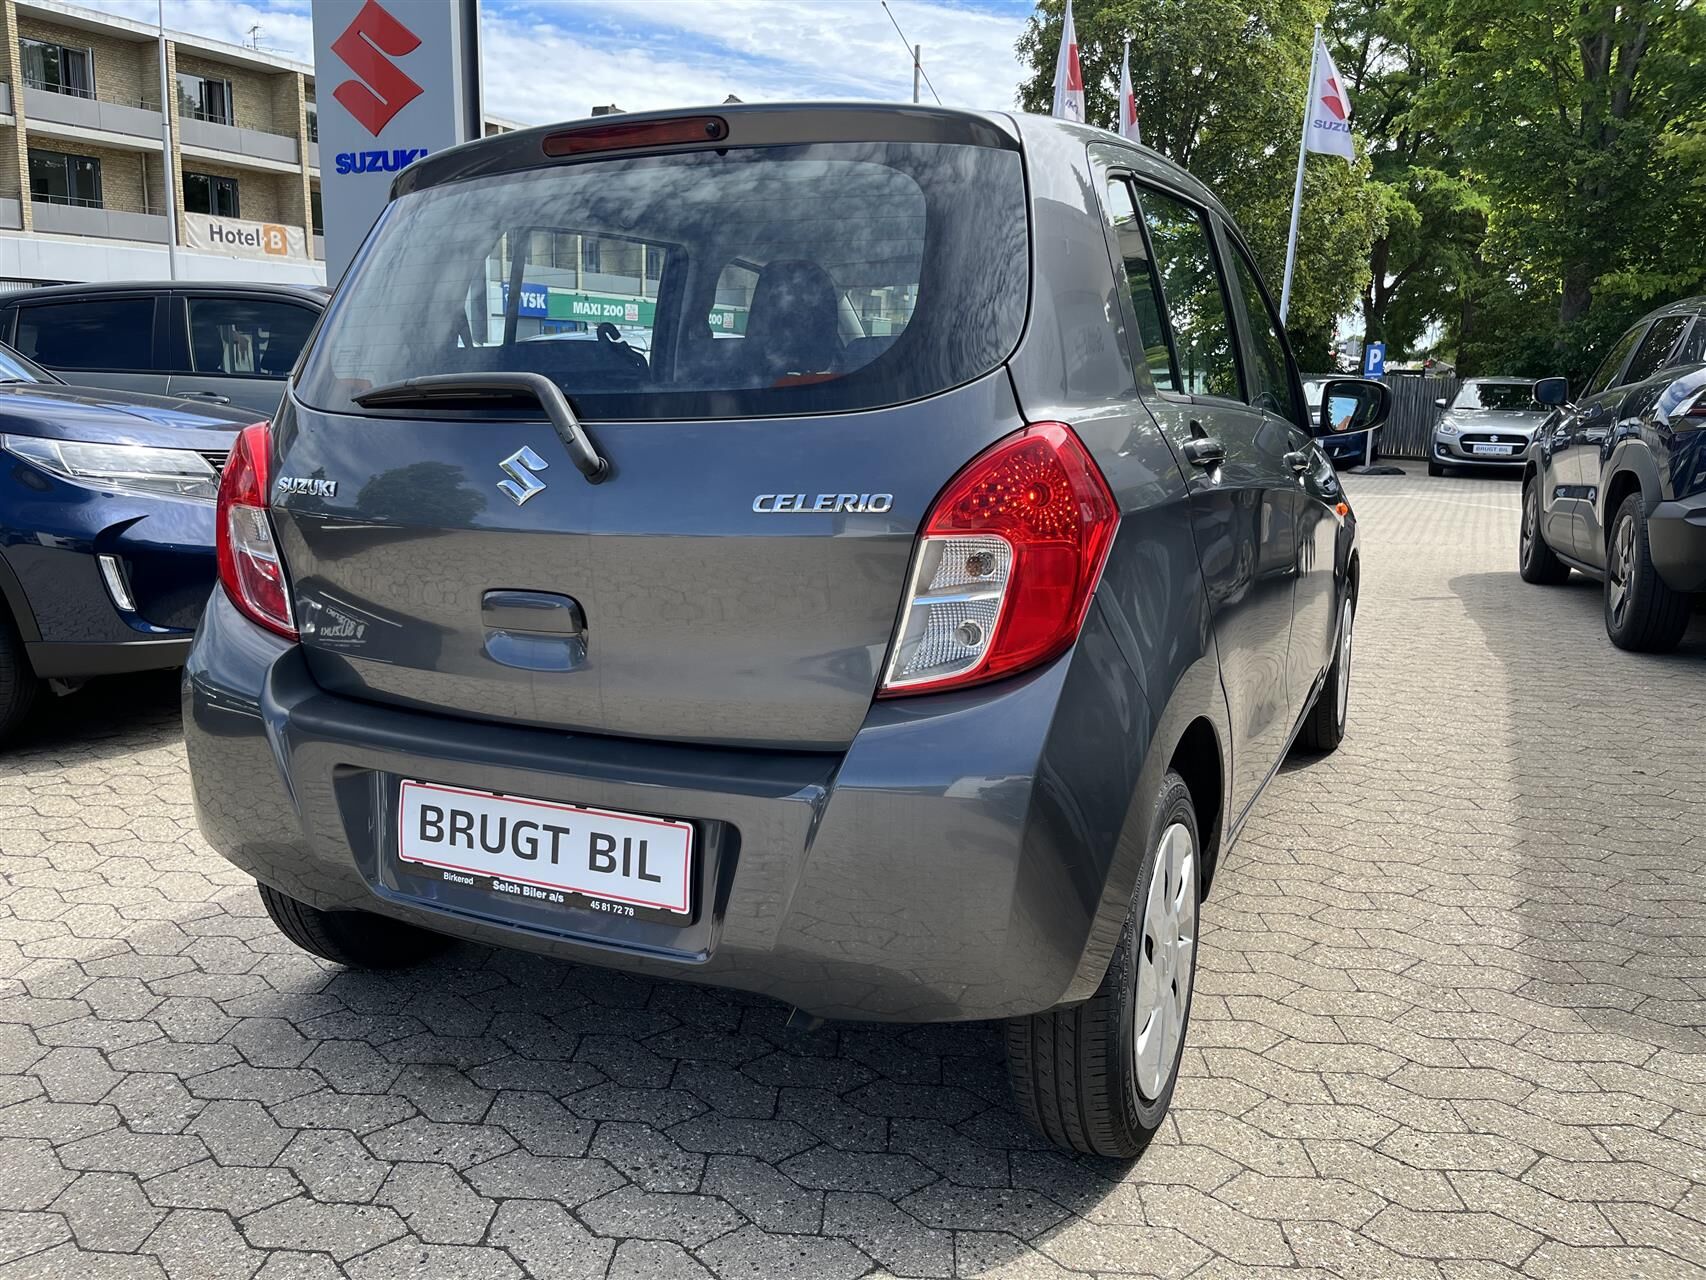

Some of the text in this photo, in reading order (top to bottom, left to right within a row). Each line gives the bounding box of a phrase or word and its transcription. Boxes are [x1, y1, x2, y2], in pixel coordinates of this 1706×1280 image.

[1313, 119, 1349, 133] SUZU
[209, 223, 282, 250] Hotel B
[520, 291, 547, 310] YSK
[572, 301, 601, 316] MAXI
[603, 304, 624, 318] ZOO
[1368, 348, 1382, 371] P
[278, 476, 337, 497] SUZUKI
[752, 493, 894, 513] CELERIO
[419, 803, 662, 883] BRUGT BIL
[443, 871, 474, 886] Birkerød
[492, 880, 565, 903] Selch Biler a/s
[590, 900, 635, 917] 45 81 72 78
